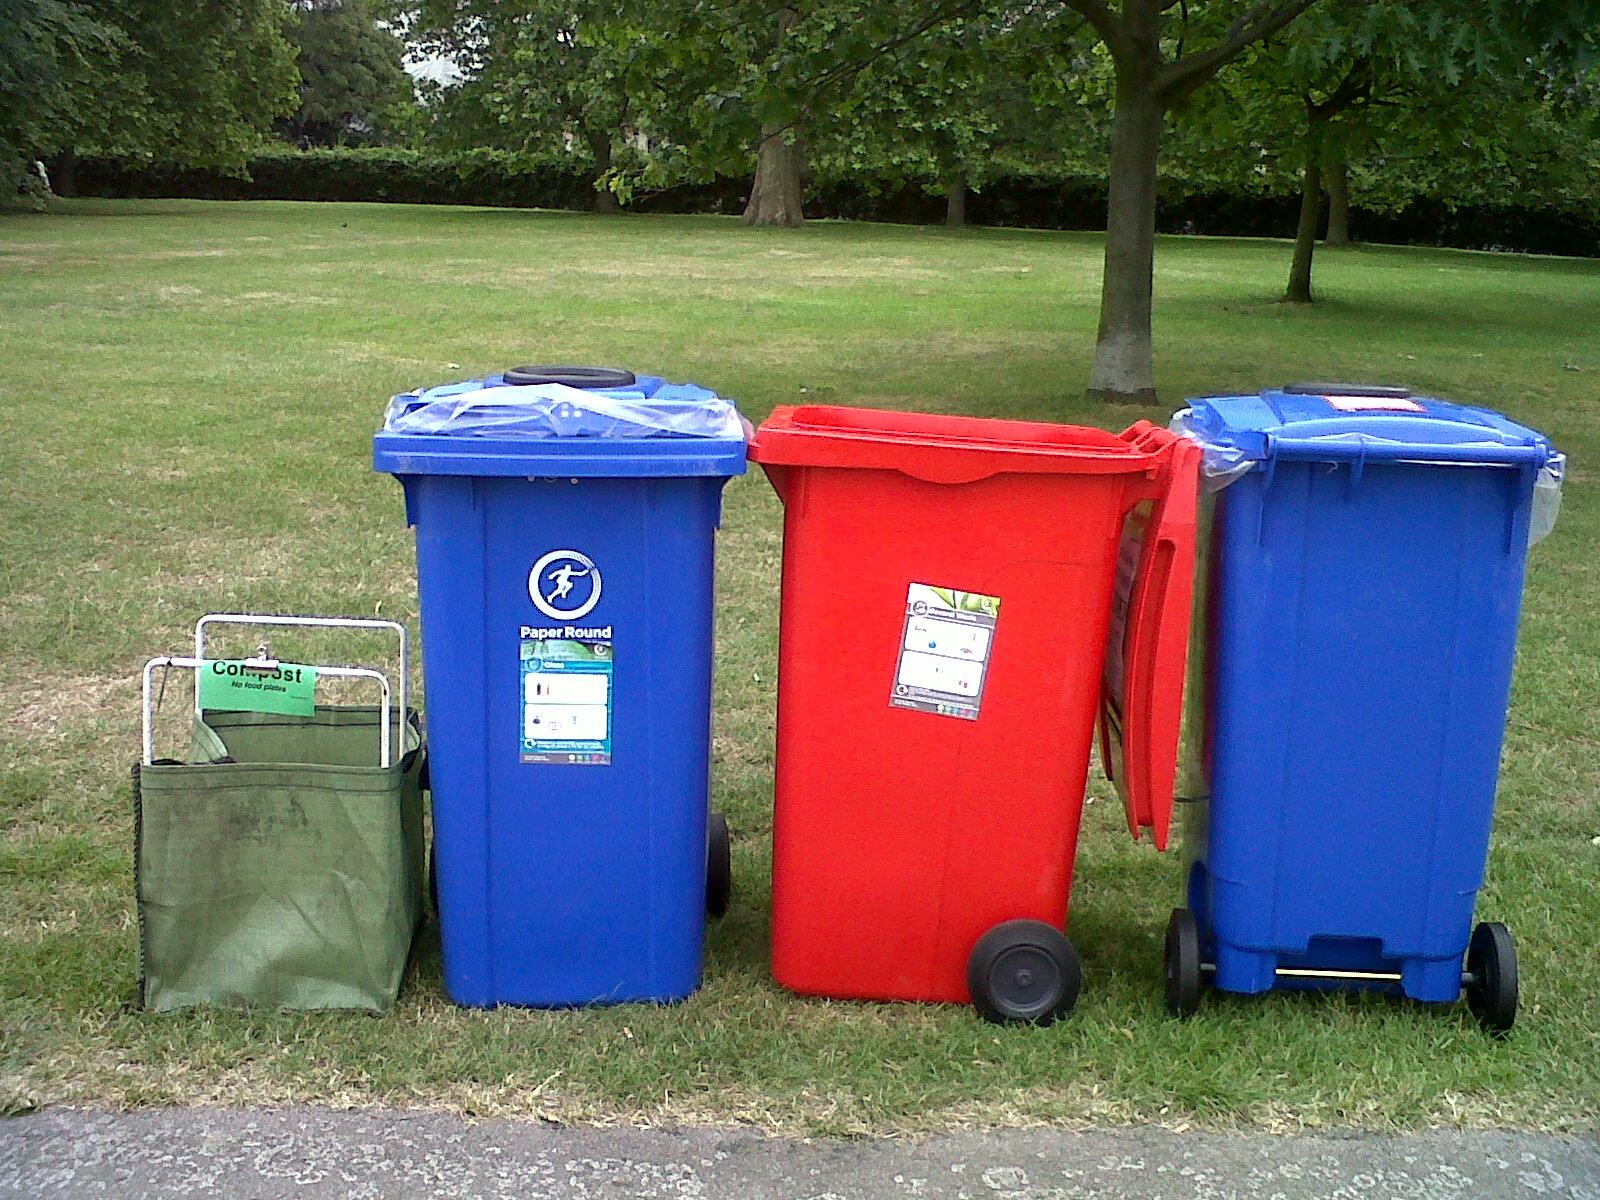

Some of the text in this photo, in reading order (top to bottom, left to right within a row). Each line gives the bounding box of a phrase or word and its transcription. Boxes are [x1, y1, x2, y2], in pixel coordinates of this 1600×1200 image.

[521, 626, 612, 641] Paper Round
[245, 681, 263, 689] food
[263, 684, 287, 692] plates
